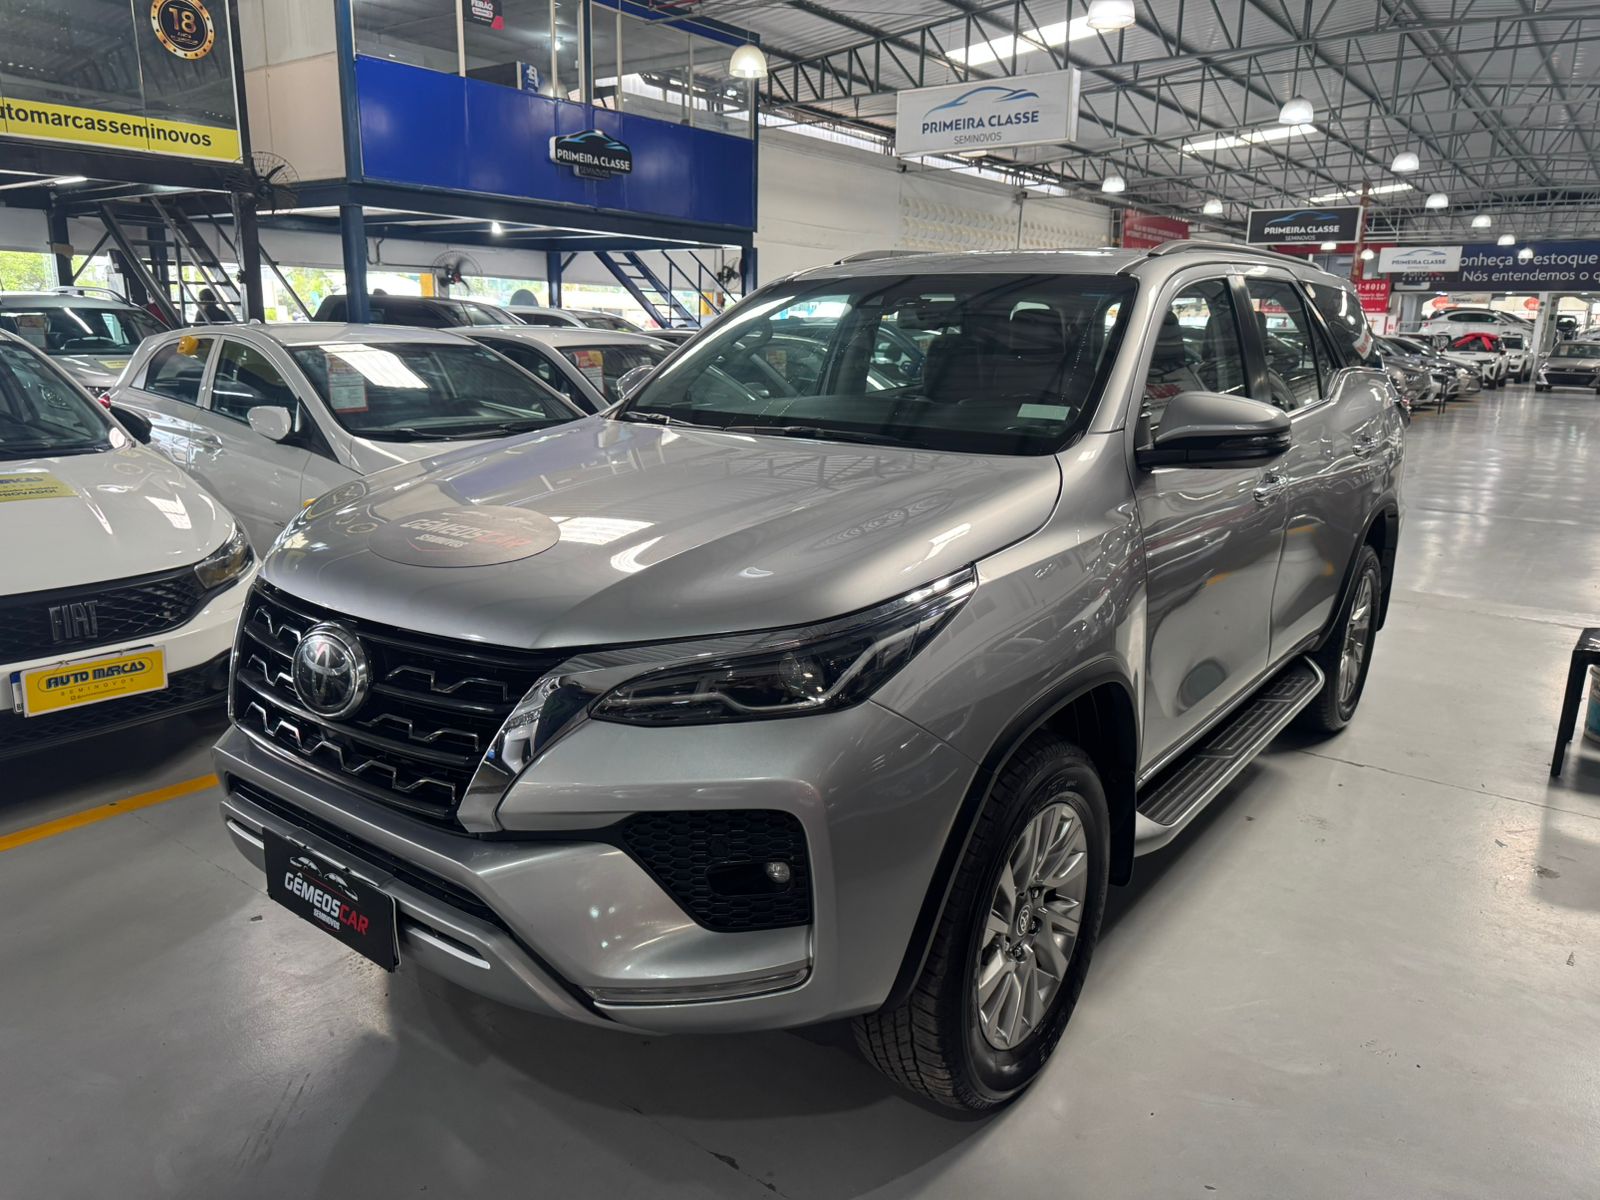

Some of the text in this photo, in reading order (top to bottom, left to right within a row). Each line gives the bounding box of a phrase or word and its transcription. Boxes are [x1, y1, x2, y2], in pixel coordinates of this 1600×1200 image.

[169, 7, 197, 33] 18
[922, 110, 1039, 134] PRIMEIRA CLASSE
[954, 132, 1002, 145] SEMINOVOS
[557, 148, 630, 171] PRIMEIRA CLASSE
[1264, 225, 1340, 235] PRIMEIRA CLASSE
[1460, 252, 1513, 268] onheça
[1533, 252, 1598, 268] estoque
[1354, 283, 1386, 291] 1-8010
[1462, 268, 1600, 284] Nós entendemos o q
[48, 600, 98, 641] FIAT
[46, 661, 146, 689] AUTO MARCAS
[60, 677, 134, 696] SEMINOVOS
[284, 871, 369, 935] GÊMEOSCAR
[313, 908, 340, 930] SEMINOVOS
